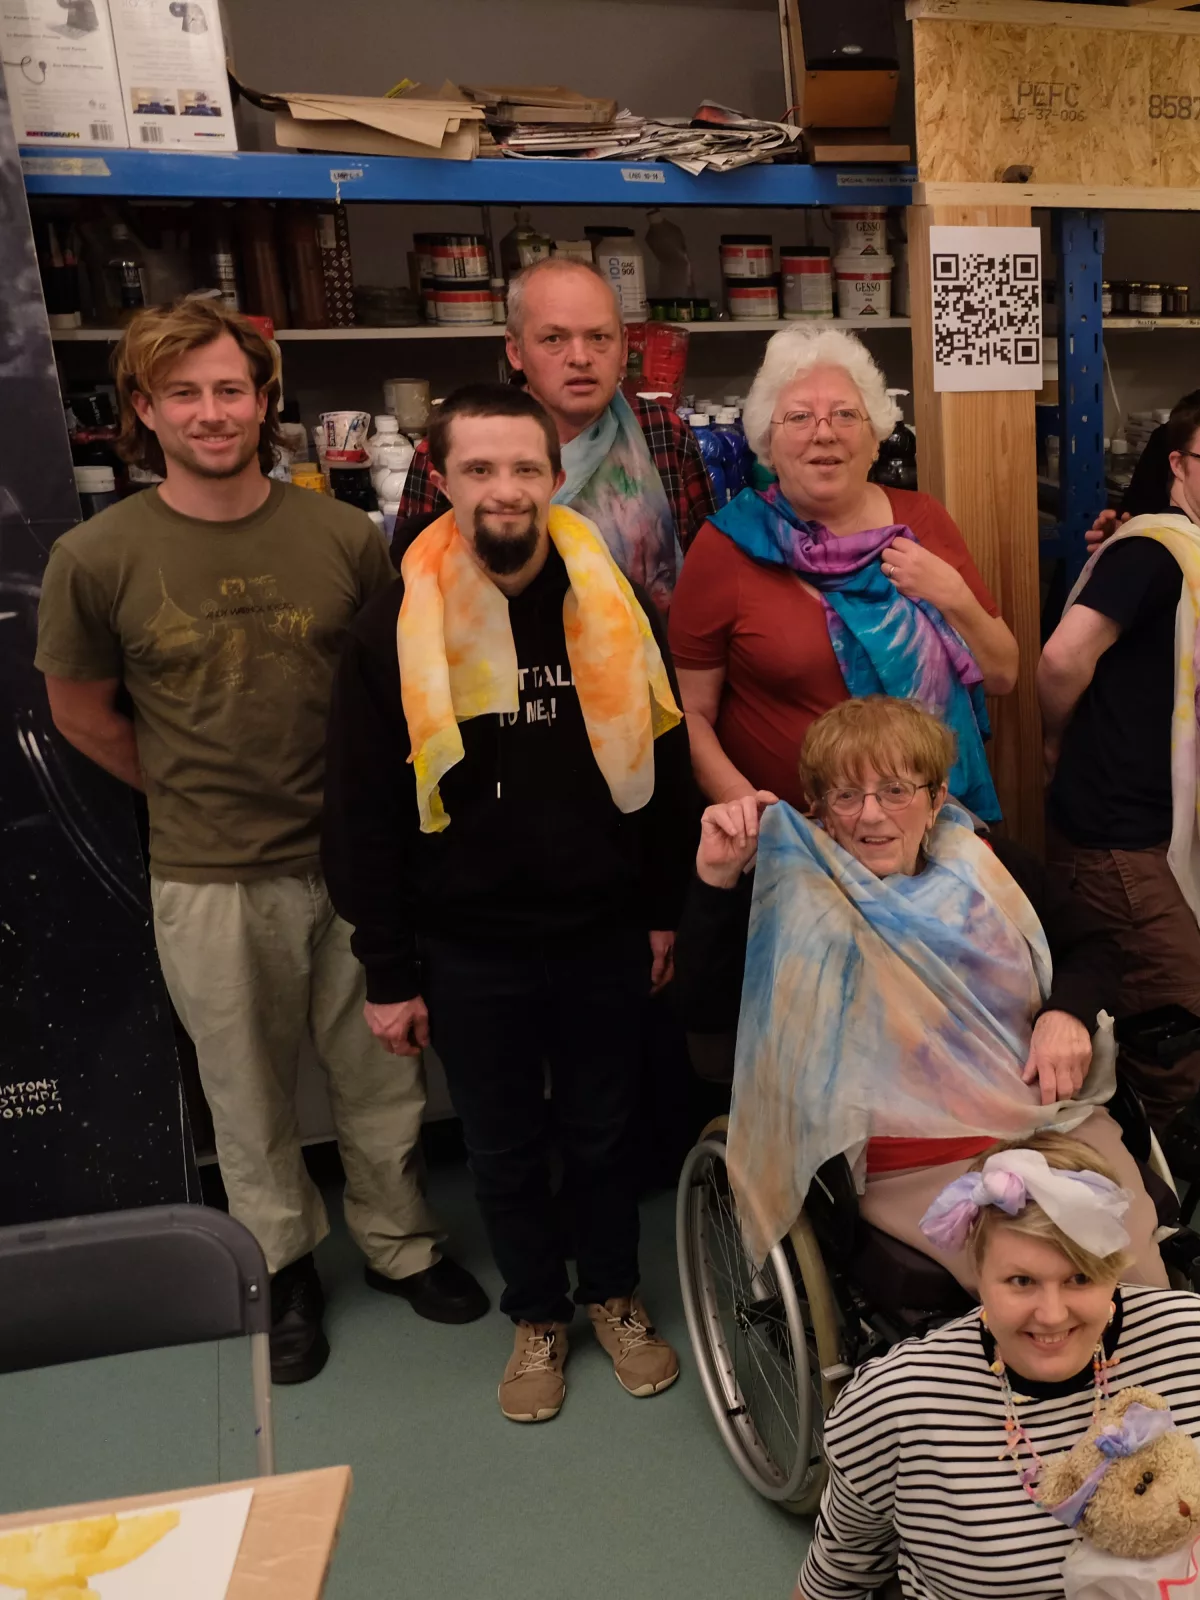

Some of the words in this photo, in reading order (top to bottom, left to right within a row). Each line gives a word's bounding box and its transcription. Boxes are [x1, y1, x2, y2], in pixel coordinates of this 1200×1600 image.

[1017, 80, 1081, 108] PEFC
[856, 222, 881, 232] GESSO
[621, 268, 635, 276] 900
[855, 282, 881, 292] GESSO
[0, 1103, 63, 1119] 0340-1
